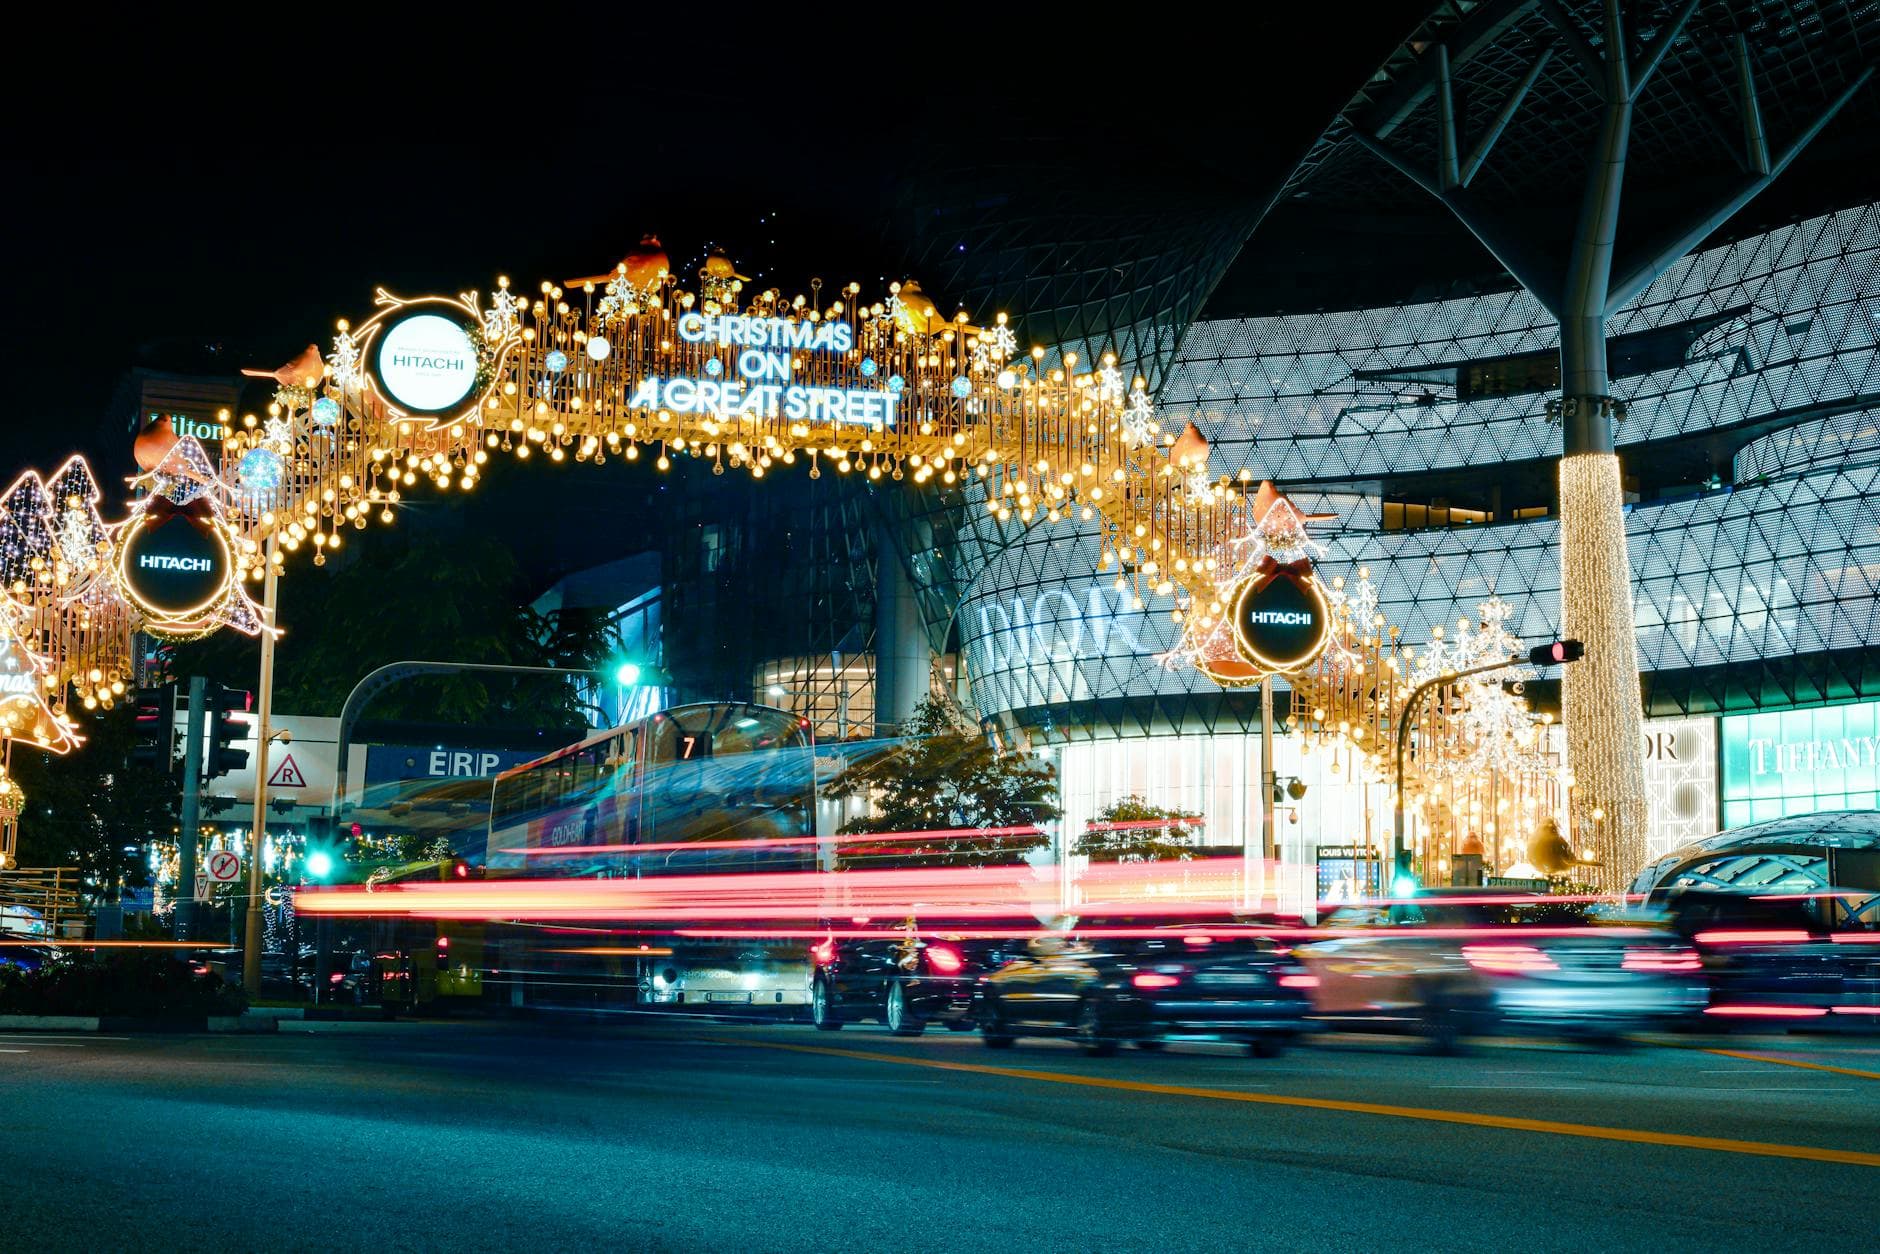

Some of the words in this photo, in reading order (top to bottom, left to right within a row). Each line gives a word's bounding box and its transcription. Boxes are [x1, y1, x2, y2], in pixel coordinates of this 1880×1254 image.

[677, 312, 852, 352] CHRISTMAS
[393, 354, 464, 371] HITACHI
[738, 350, 791, 381] ON
[629, 377, 659, 411] A
[663, 378, 783, 418] GREAT
[785, 384, 901, 426] STREET
[149, 412, 224, 441] ilton
[140, 554, 212, 571] HITACHI
[1251, 611, 1312, 625] HITACHI
[683, 737, 696, 759] 7
[429, 751, 500, 777] ERP
[1319, 848, 1341, 857] LOUIS
[1490, 879, 1533, 889] PATERSON
[1535, 880, 1547, 890] RD
